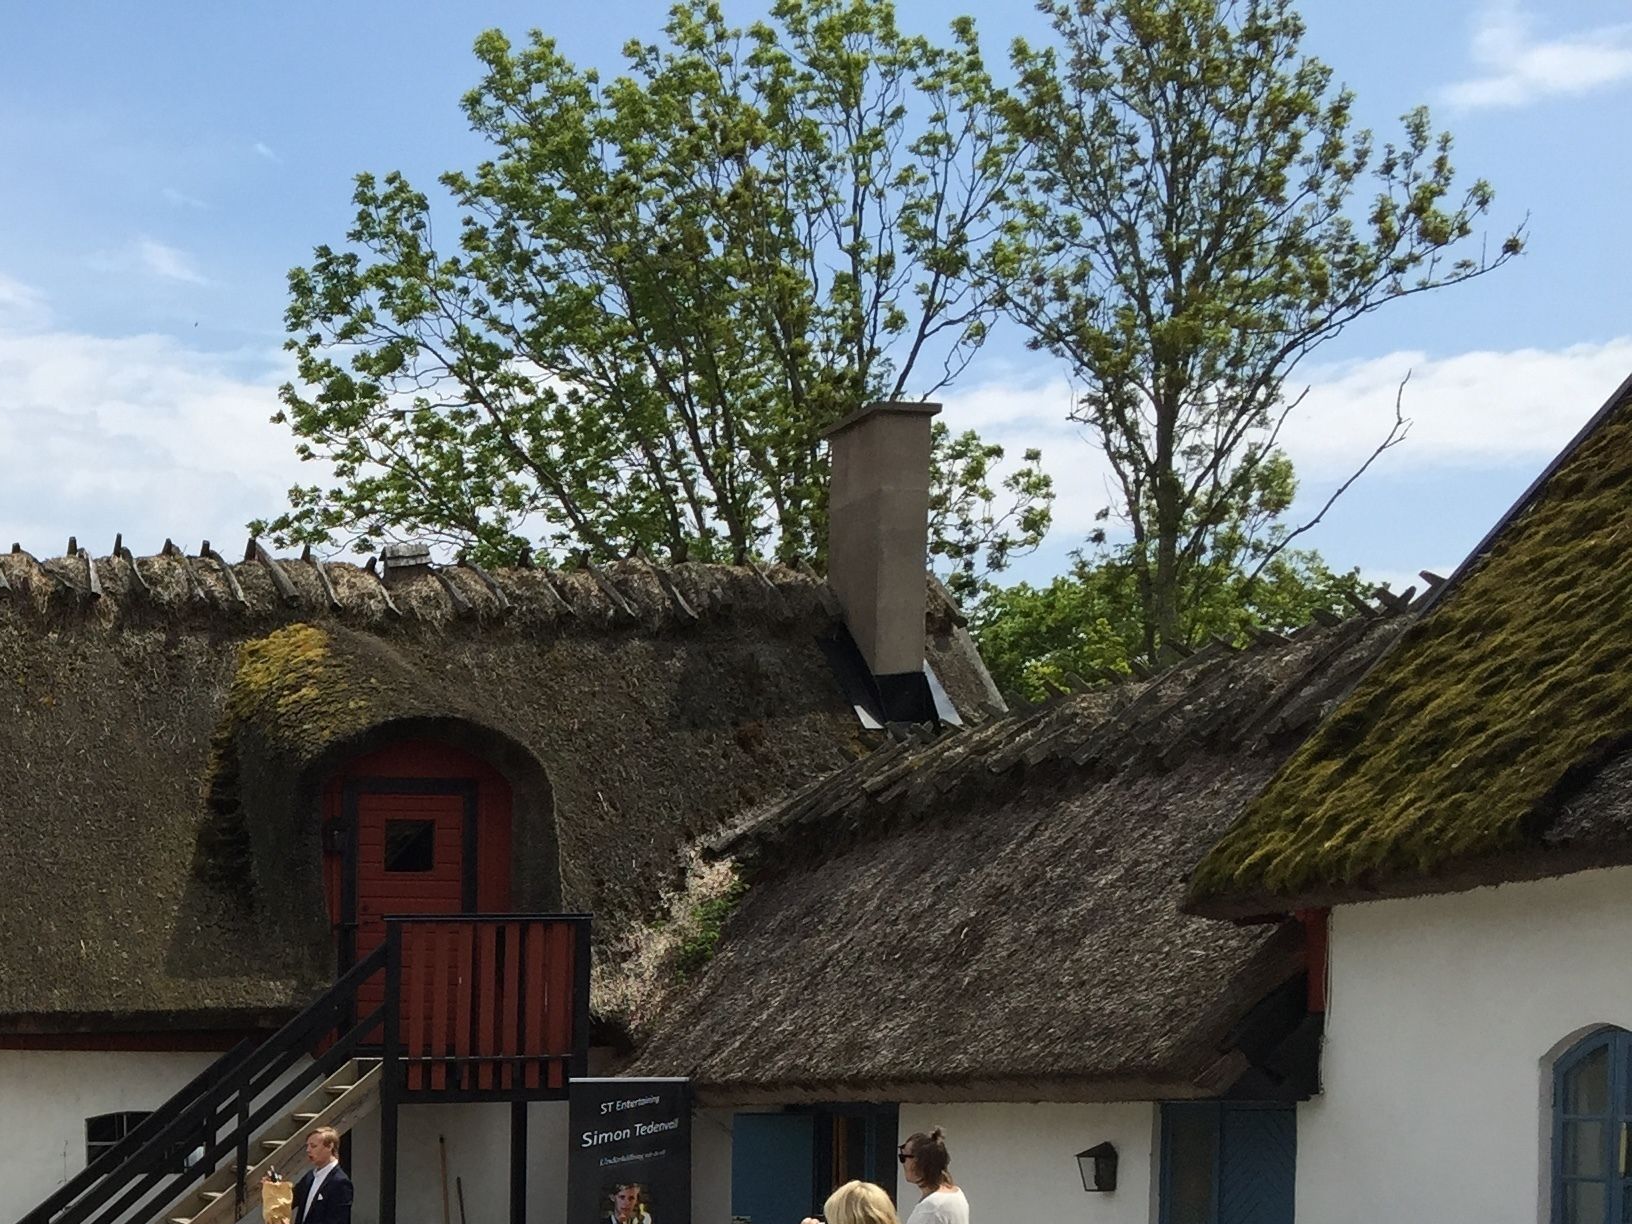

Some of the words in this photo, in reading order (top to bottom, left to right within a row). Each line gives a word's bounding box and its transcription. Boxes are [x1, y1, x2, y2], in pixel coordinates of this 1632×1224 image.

[600, 1102, 614, 1115] ST
[616, 1095, 661, 1111] Entertaining
[581, 1128, 631, 1148] Simon
